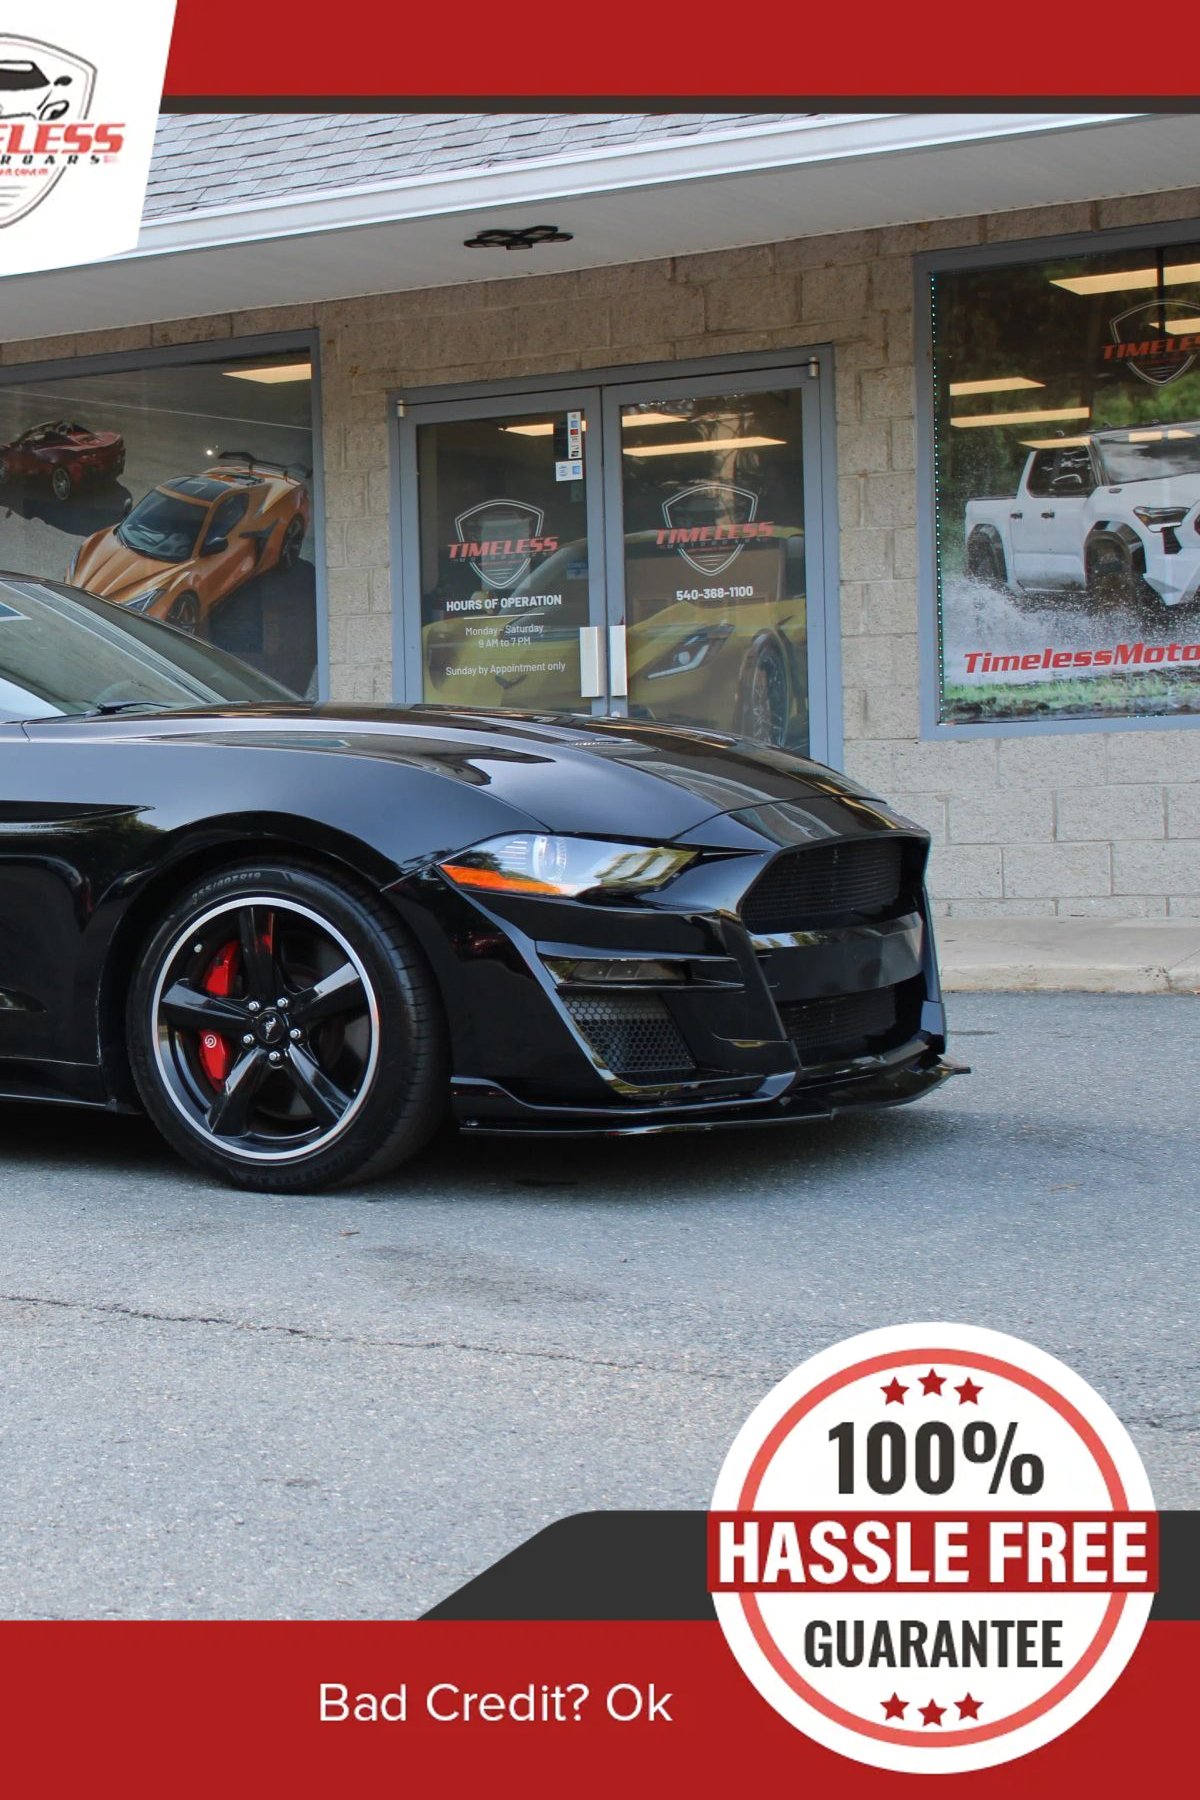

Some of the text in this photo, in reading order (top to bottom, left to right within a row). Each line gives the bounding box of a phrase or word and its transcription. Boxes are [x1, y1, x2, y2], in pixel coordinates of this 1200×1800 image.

[656, 521, 775, 545] TIMELESS
[447, 536, 560, 559] TIMELESS
[446, 594, 562, 612] HOURS OF OPERATION
[465, 625, 498, 637] Monday
[505, 623, 544, 635] Saturday
[485, 638, 499, 648] AM
[500, 638, 510, 647] to
[517, 636, 531, 646] PM
[445, 661, 566, 676] Sunday by Appointment only
